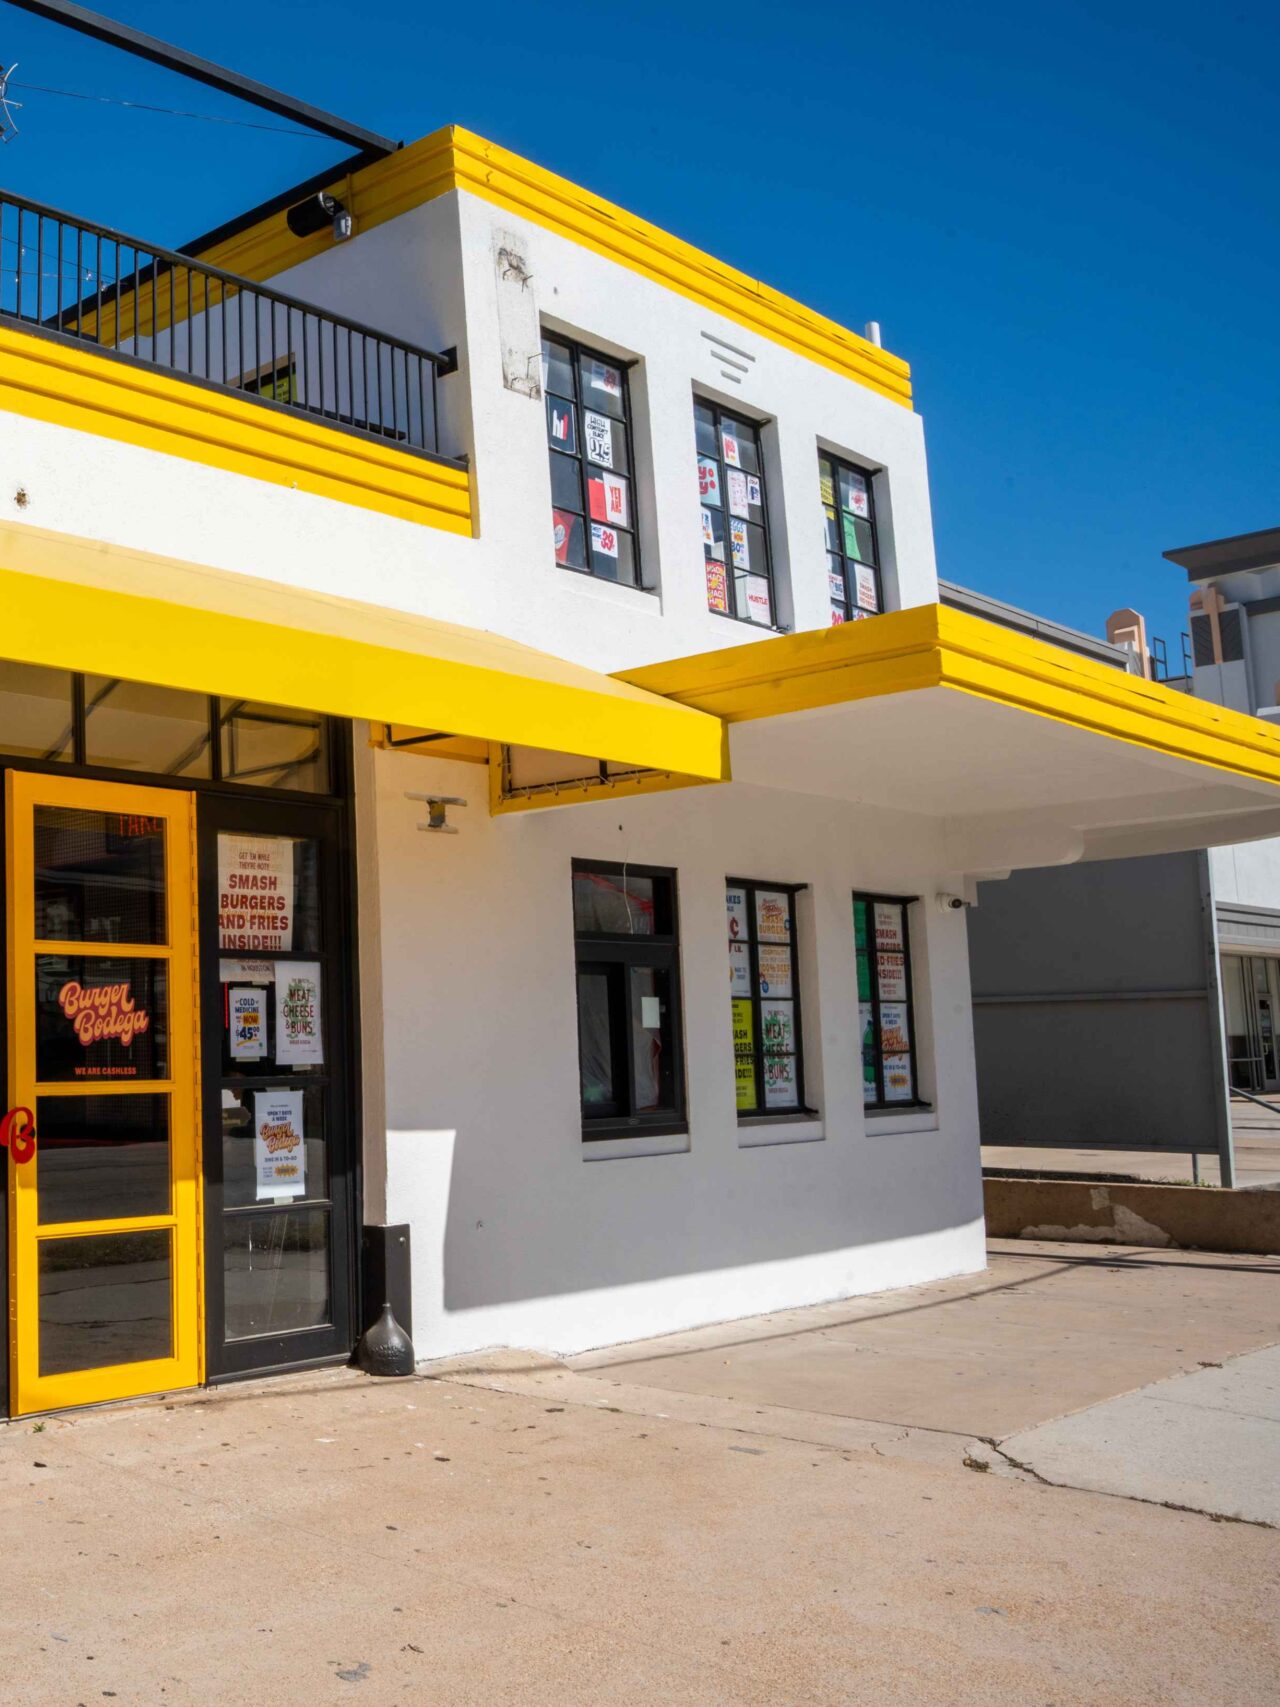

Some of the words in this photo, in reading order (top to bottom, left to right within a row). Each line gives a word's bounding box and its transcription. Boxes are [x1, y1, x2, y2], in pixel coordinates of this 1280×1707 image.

[229, 874, 277, 891] SMASH
[221, 894, 285, 911] BURGERS
[726, 896, 741, 904] KES
[218, 914, 245, 929] AND
[250, 915, 289, 930] FRIES
[222, 934, 281, 949] INSIDE!!!
[879, 969, 902, 979] SIDE!!!
[59, 981, 135, 1019] Burger
[289, 989, 310, 1001] MEAT
[240, 998, 255, 1006] COLD
[283, 1005, 314, 1017] CHEESE
[74, 1006, 149, 1046] Bodega
[291, 1021, 313, 1034] BUNS
[733, 1030, 747, 1039] ASH
[735, 1043, 752, 1052] GERS
[735, 1068, 752, 1078] IDE!!!
[769, 1064, 789, 1079] BUNS
